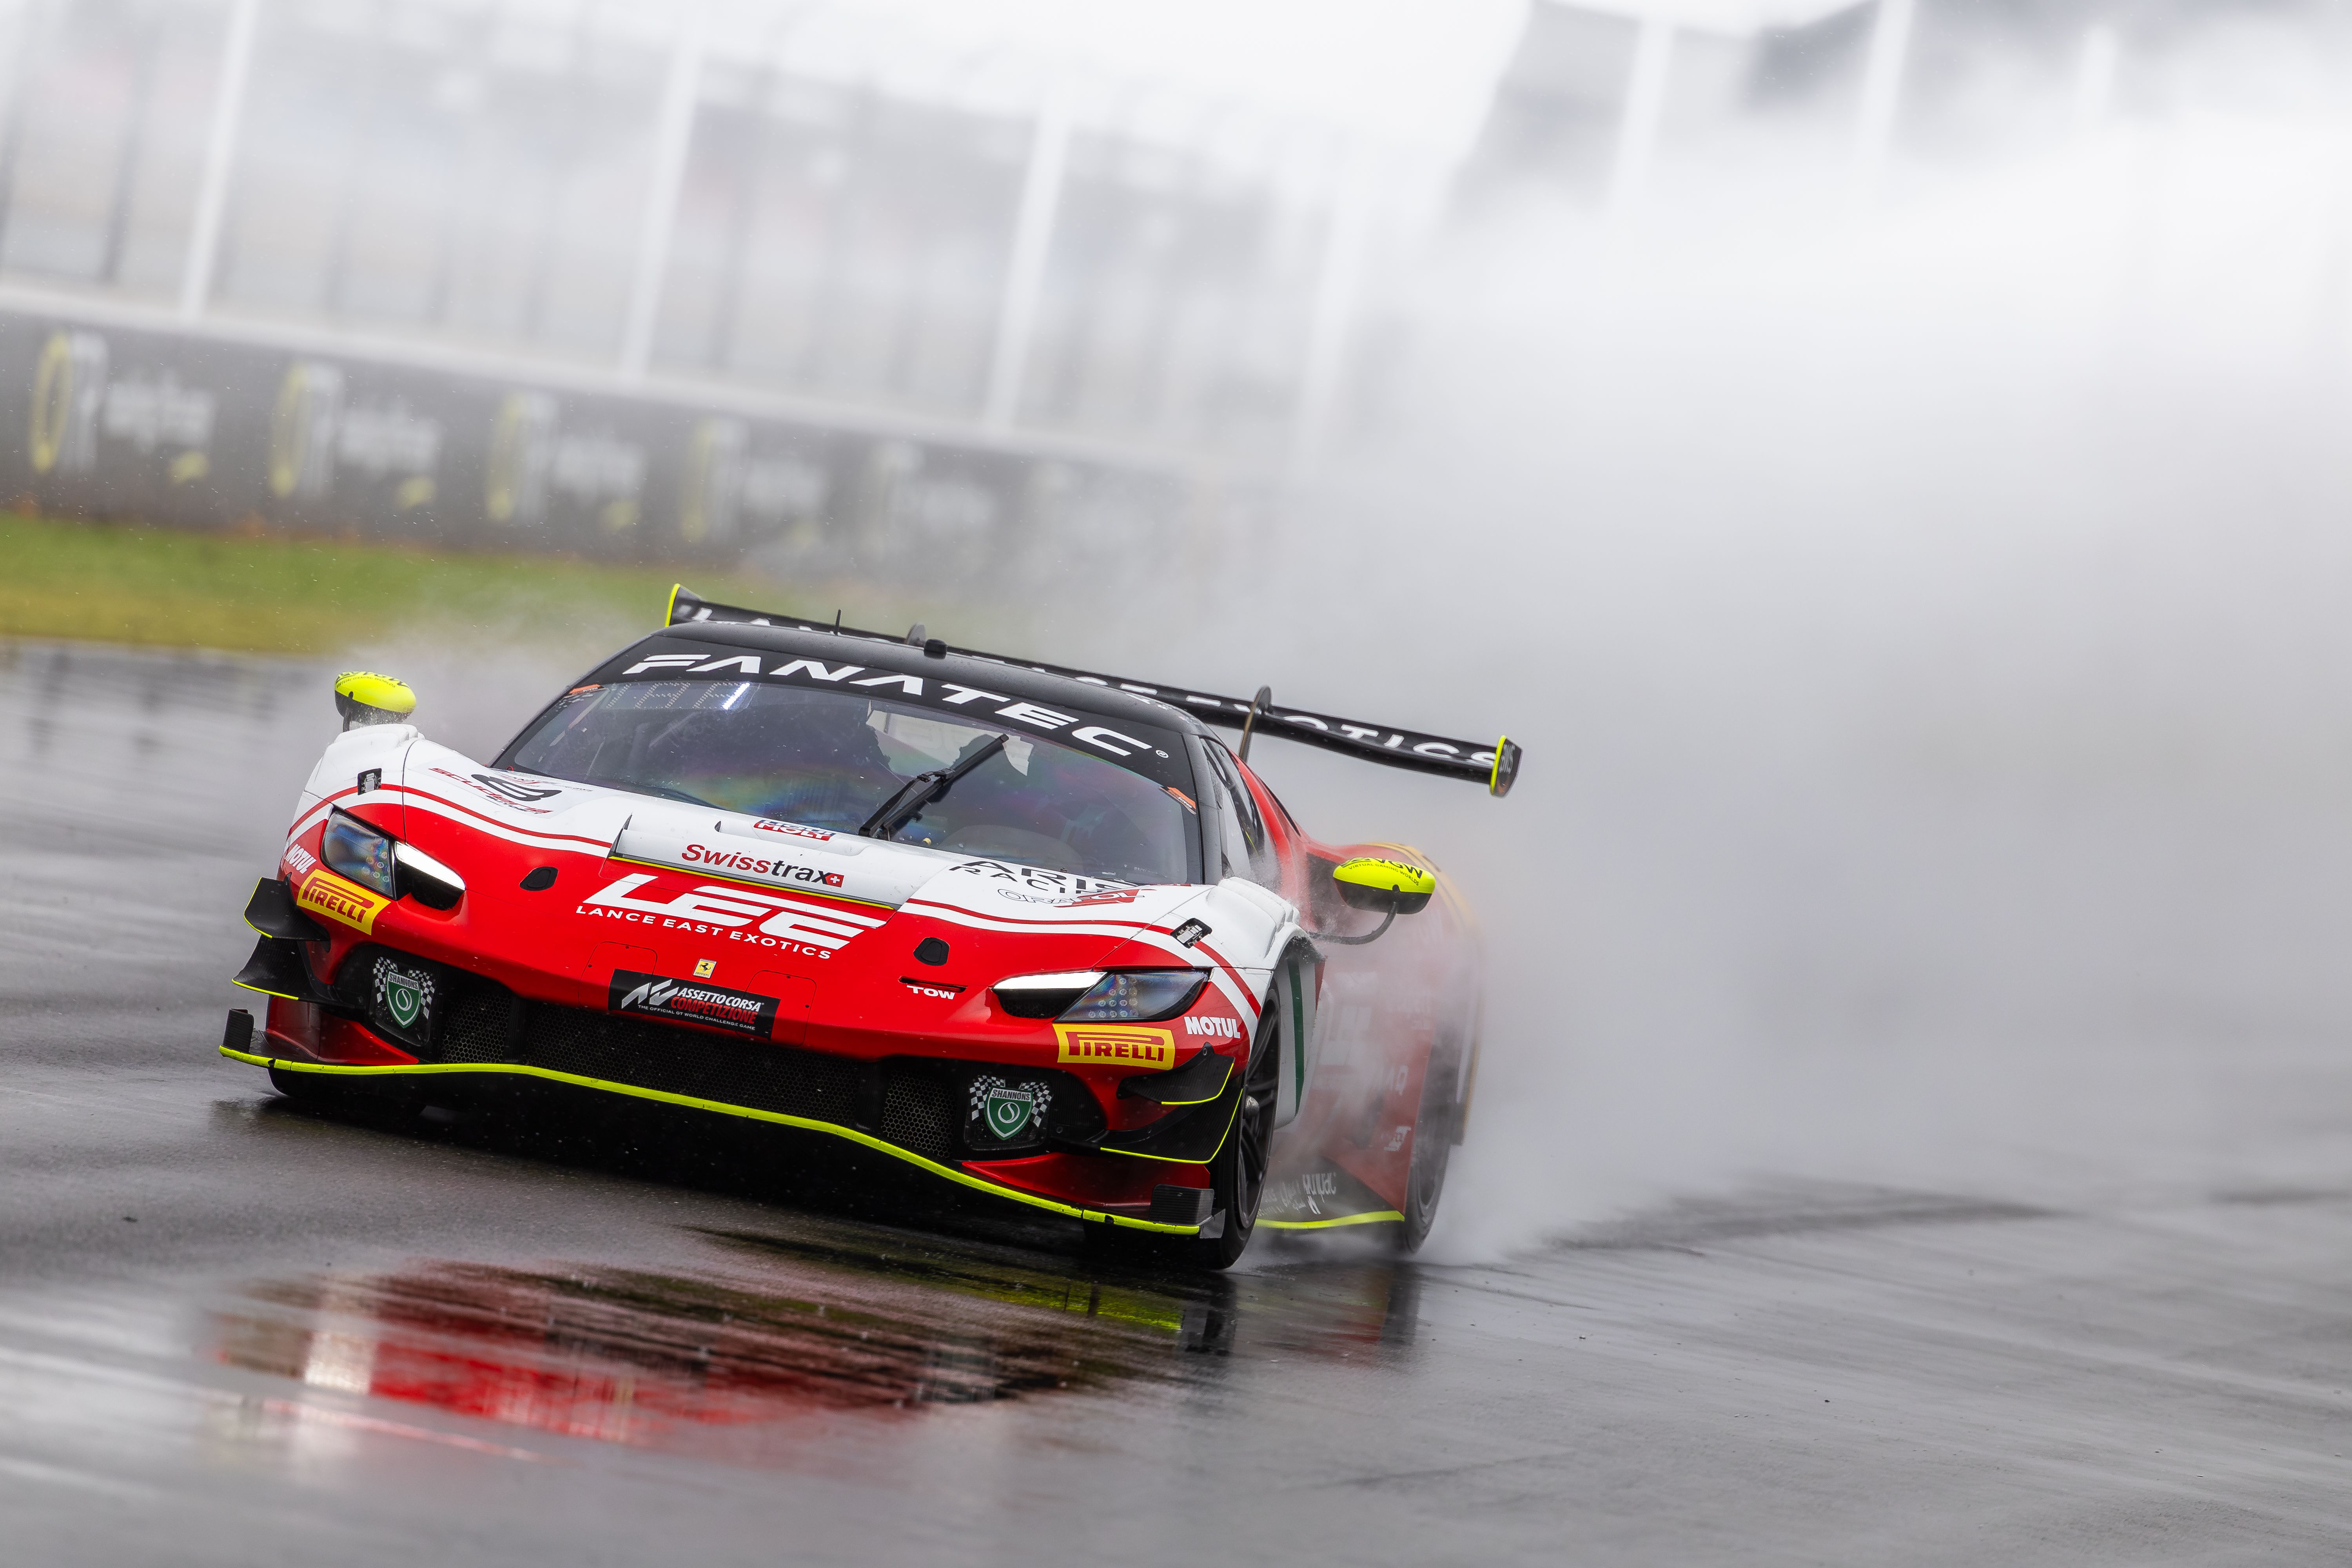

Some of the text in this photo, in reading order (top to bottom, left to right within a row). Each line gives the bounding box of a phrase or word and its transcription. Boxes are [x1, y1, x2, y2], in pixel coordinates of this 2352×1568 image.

[758, 823, 831, 839] MOLY
[284, 843, 317, 874] MOTUL
[682, 844, 831, 885] Swisstrax
[1375, 863, 1399, 872] GAMING
[1400, 870, 1420, 886] WORLDS
[301, 877, 375, 924] PIRELLI
[998, 888, 1145, 904] ORAFOL
[582, 873, 887, 950] LEE
[576, 906, 832, 959] LANCE EAST EXOTICS
[388, 974, 418, 990] SHANNONS
[906, 985, 955, 1000] TOW
[677, 987, 726, 1004] ASSETTO
[671, 996, 758, 1024] COMPETIZIONE
[705, 1016, 739, 1027] CHALLENGE
[1184, 1016, 1241, 1039] MOTUL
[1065, 1031, 1165, 1062] PIRELLI
[992, 1089, 1030, 1101] SHANNONS
